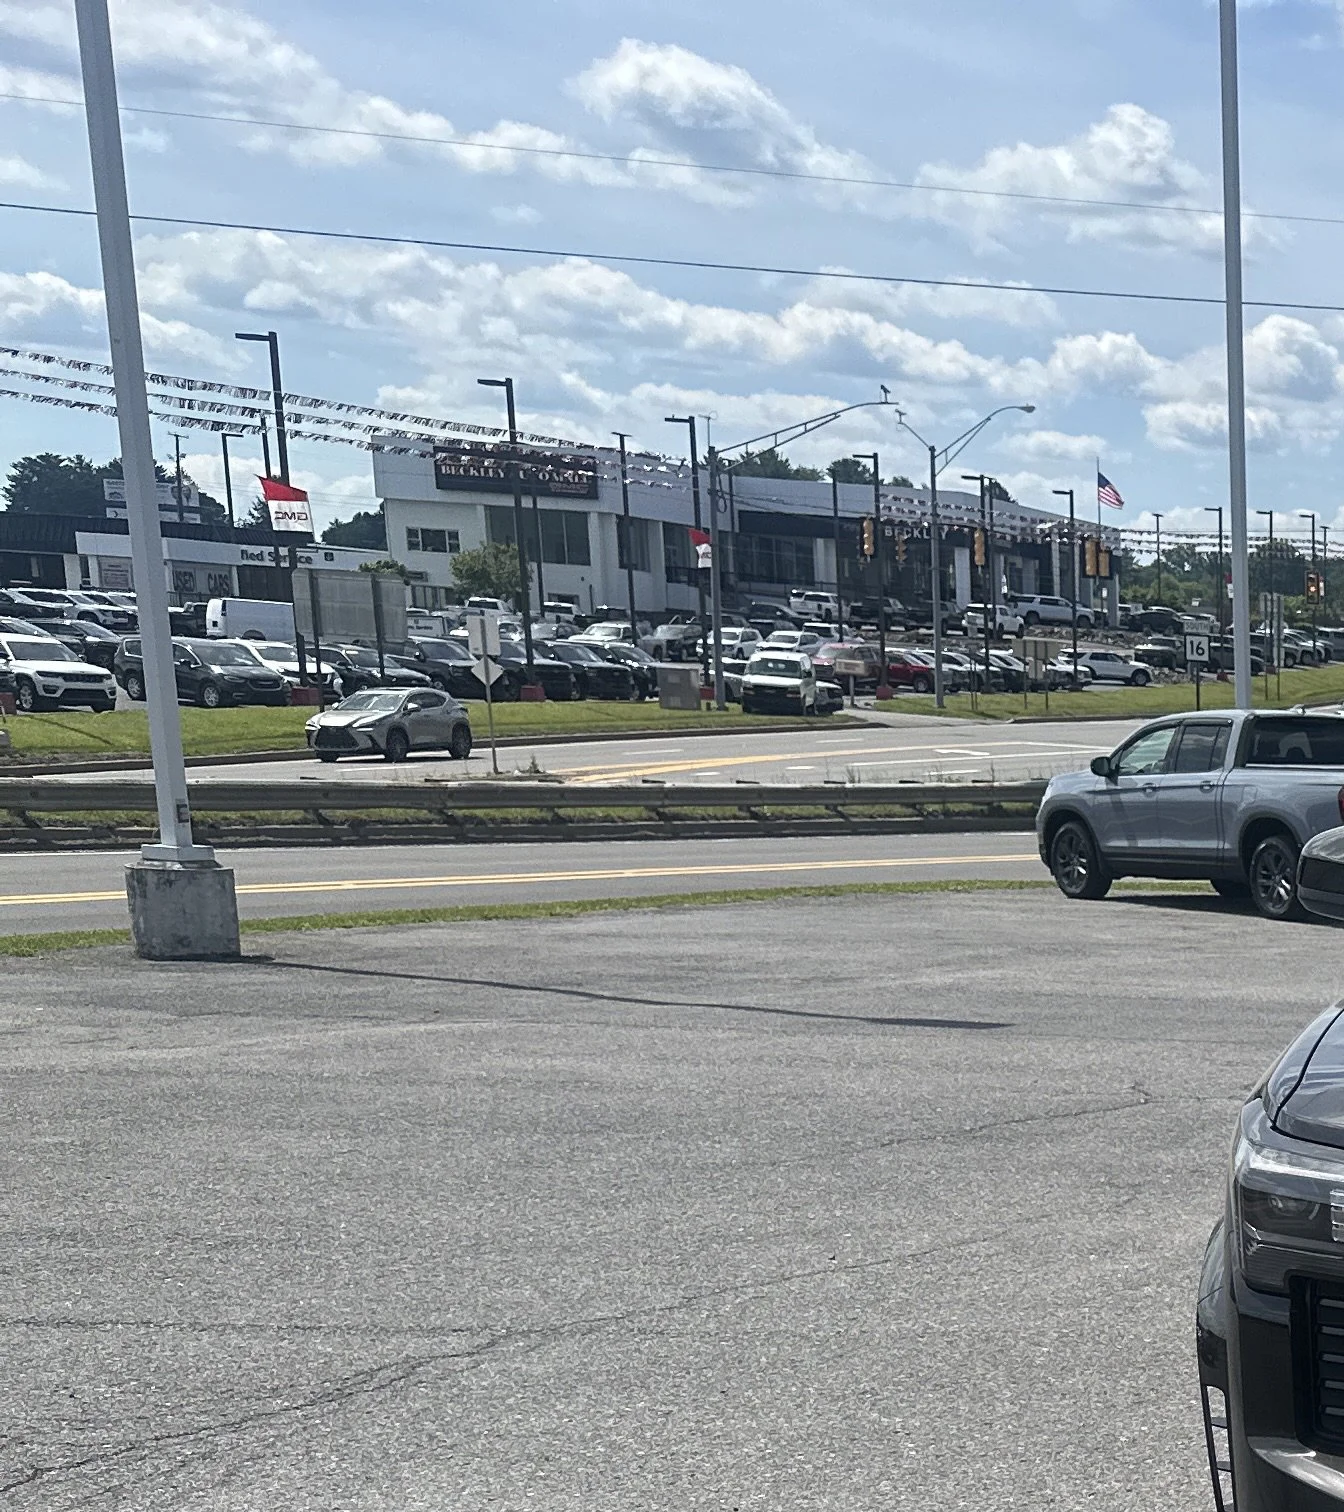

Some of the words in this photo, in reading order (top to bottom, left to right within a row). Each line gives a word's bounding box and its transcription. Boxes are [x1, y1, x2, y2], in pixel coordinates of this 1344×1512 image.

[440, 464, 506, 479] BECKLEY
[884, 525, 949, 540] BECKLY
[1190, 640, 1205, 656] 16
